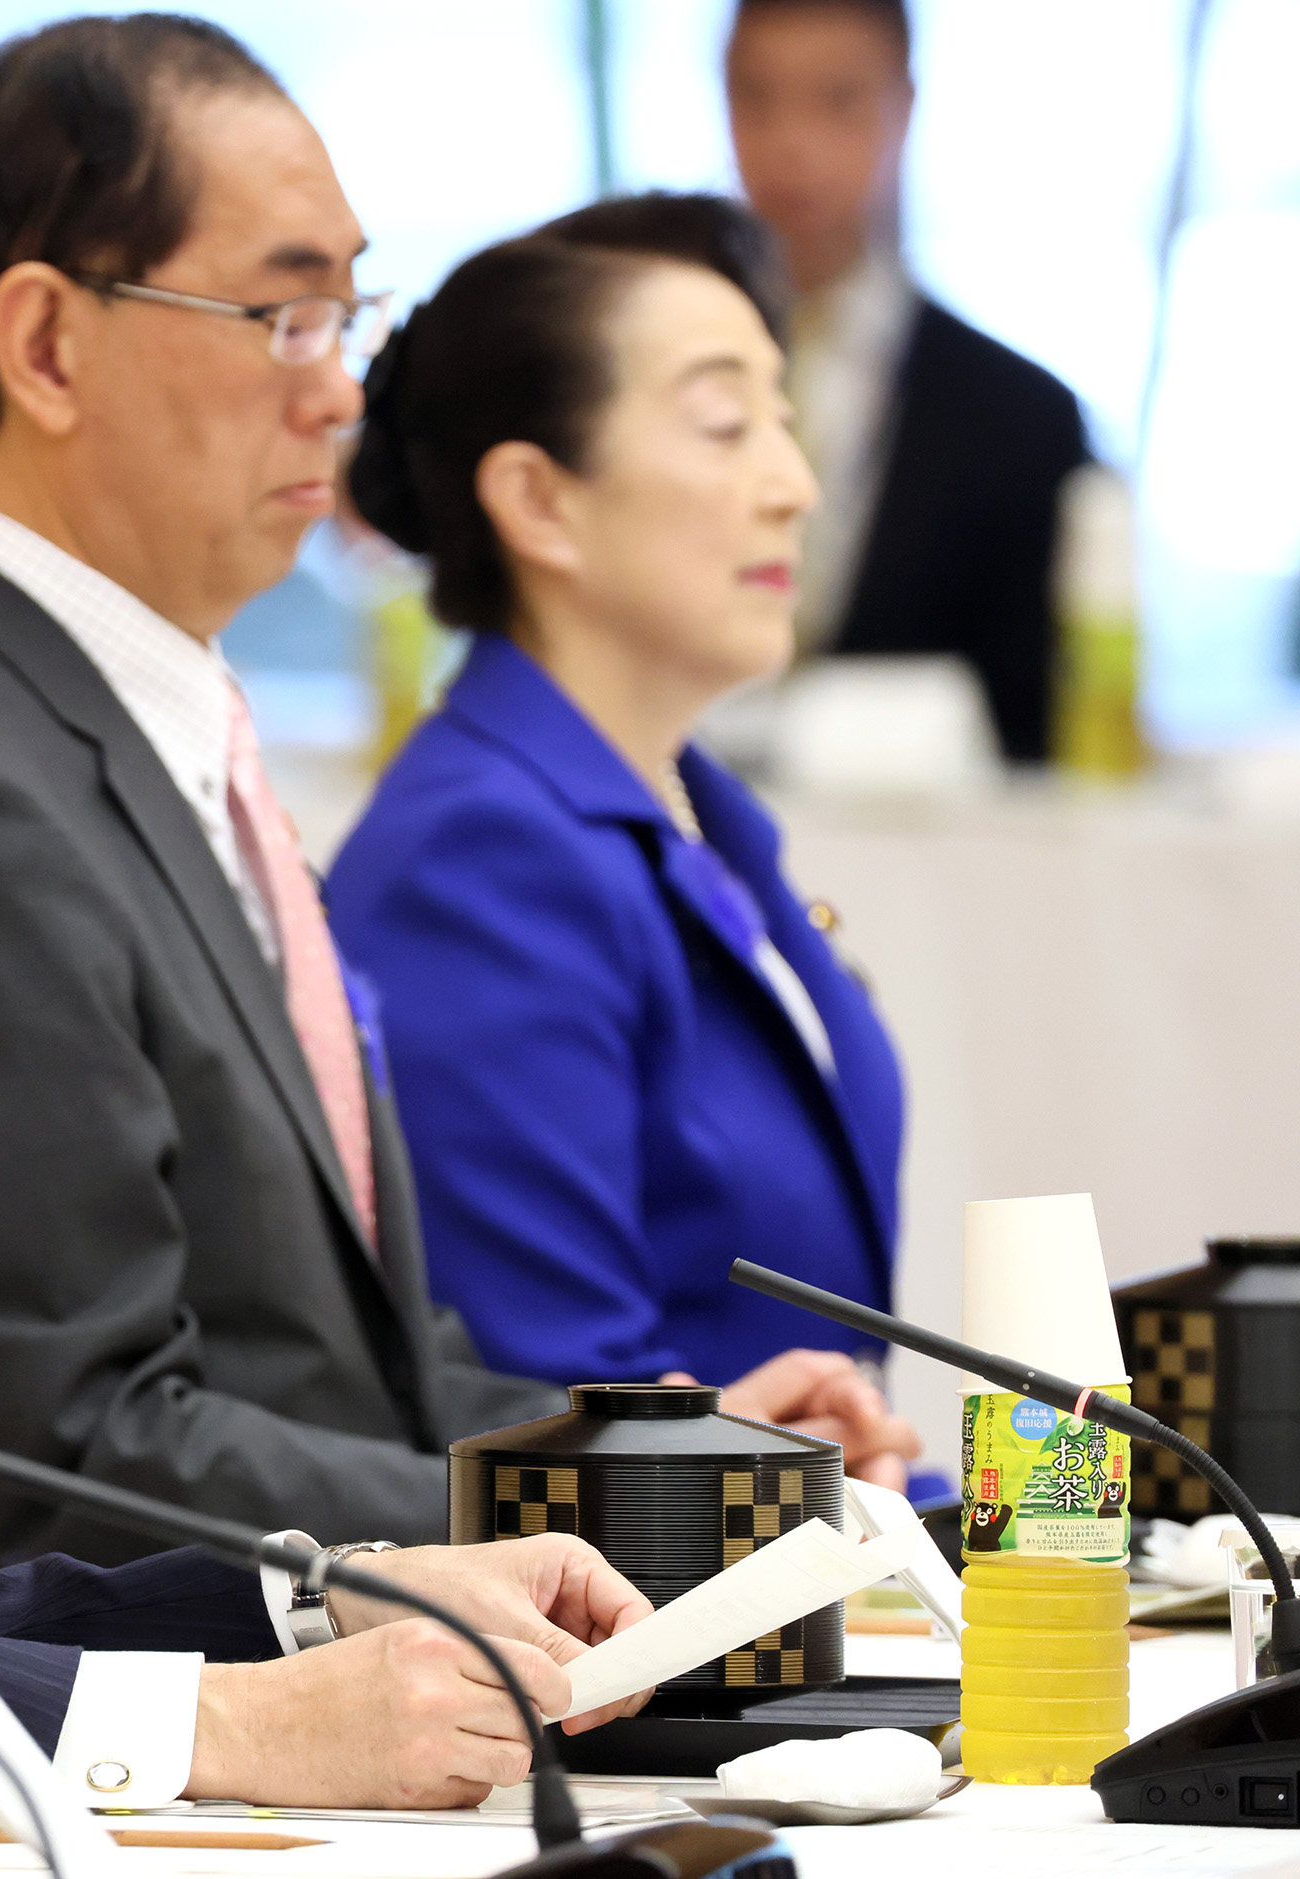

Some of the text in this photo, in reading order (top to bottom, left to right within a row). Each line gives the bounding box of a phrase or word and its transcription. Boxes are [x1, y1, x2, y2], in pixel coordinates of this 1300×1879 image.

[1019, 1407, 1048, 1417] 熊本城
[1015, 1418, 1053, 1429] 復旧応援
[1048, 1437, 1088, 1512] お茶
